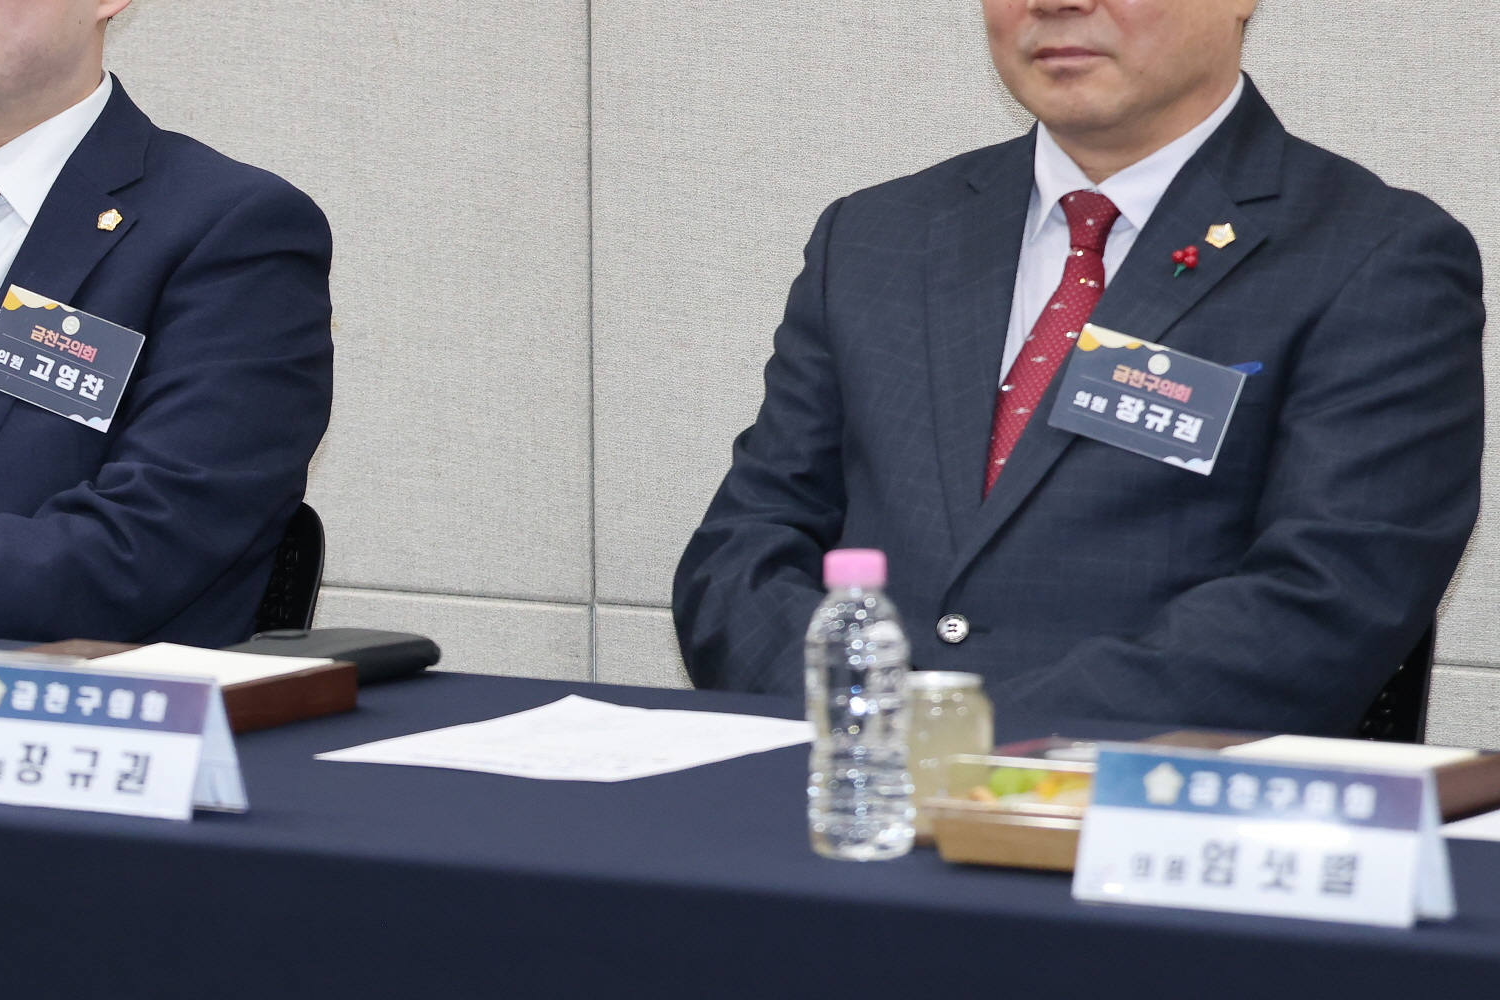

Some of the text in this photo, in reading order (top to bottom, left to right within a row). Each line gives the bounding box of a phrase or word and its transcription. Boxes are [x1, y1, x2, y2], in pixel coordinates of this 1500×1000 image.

[30, 324, 98, 363] 금천구의회
[29, 353, 104, 401] 고영찬
[1112, 363, 1193, 403] 금천구의회
[1072, 390, 1204, 443] 의원 장규권
